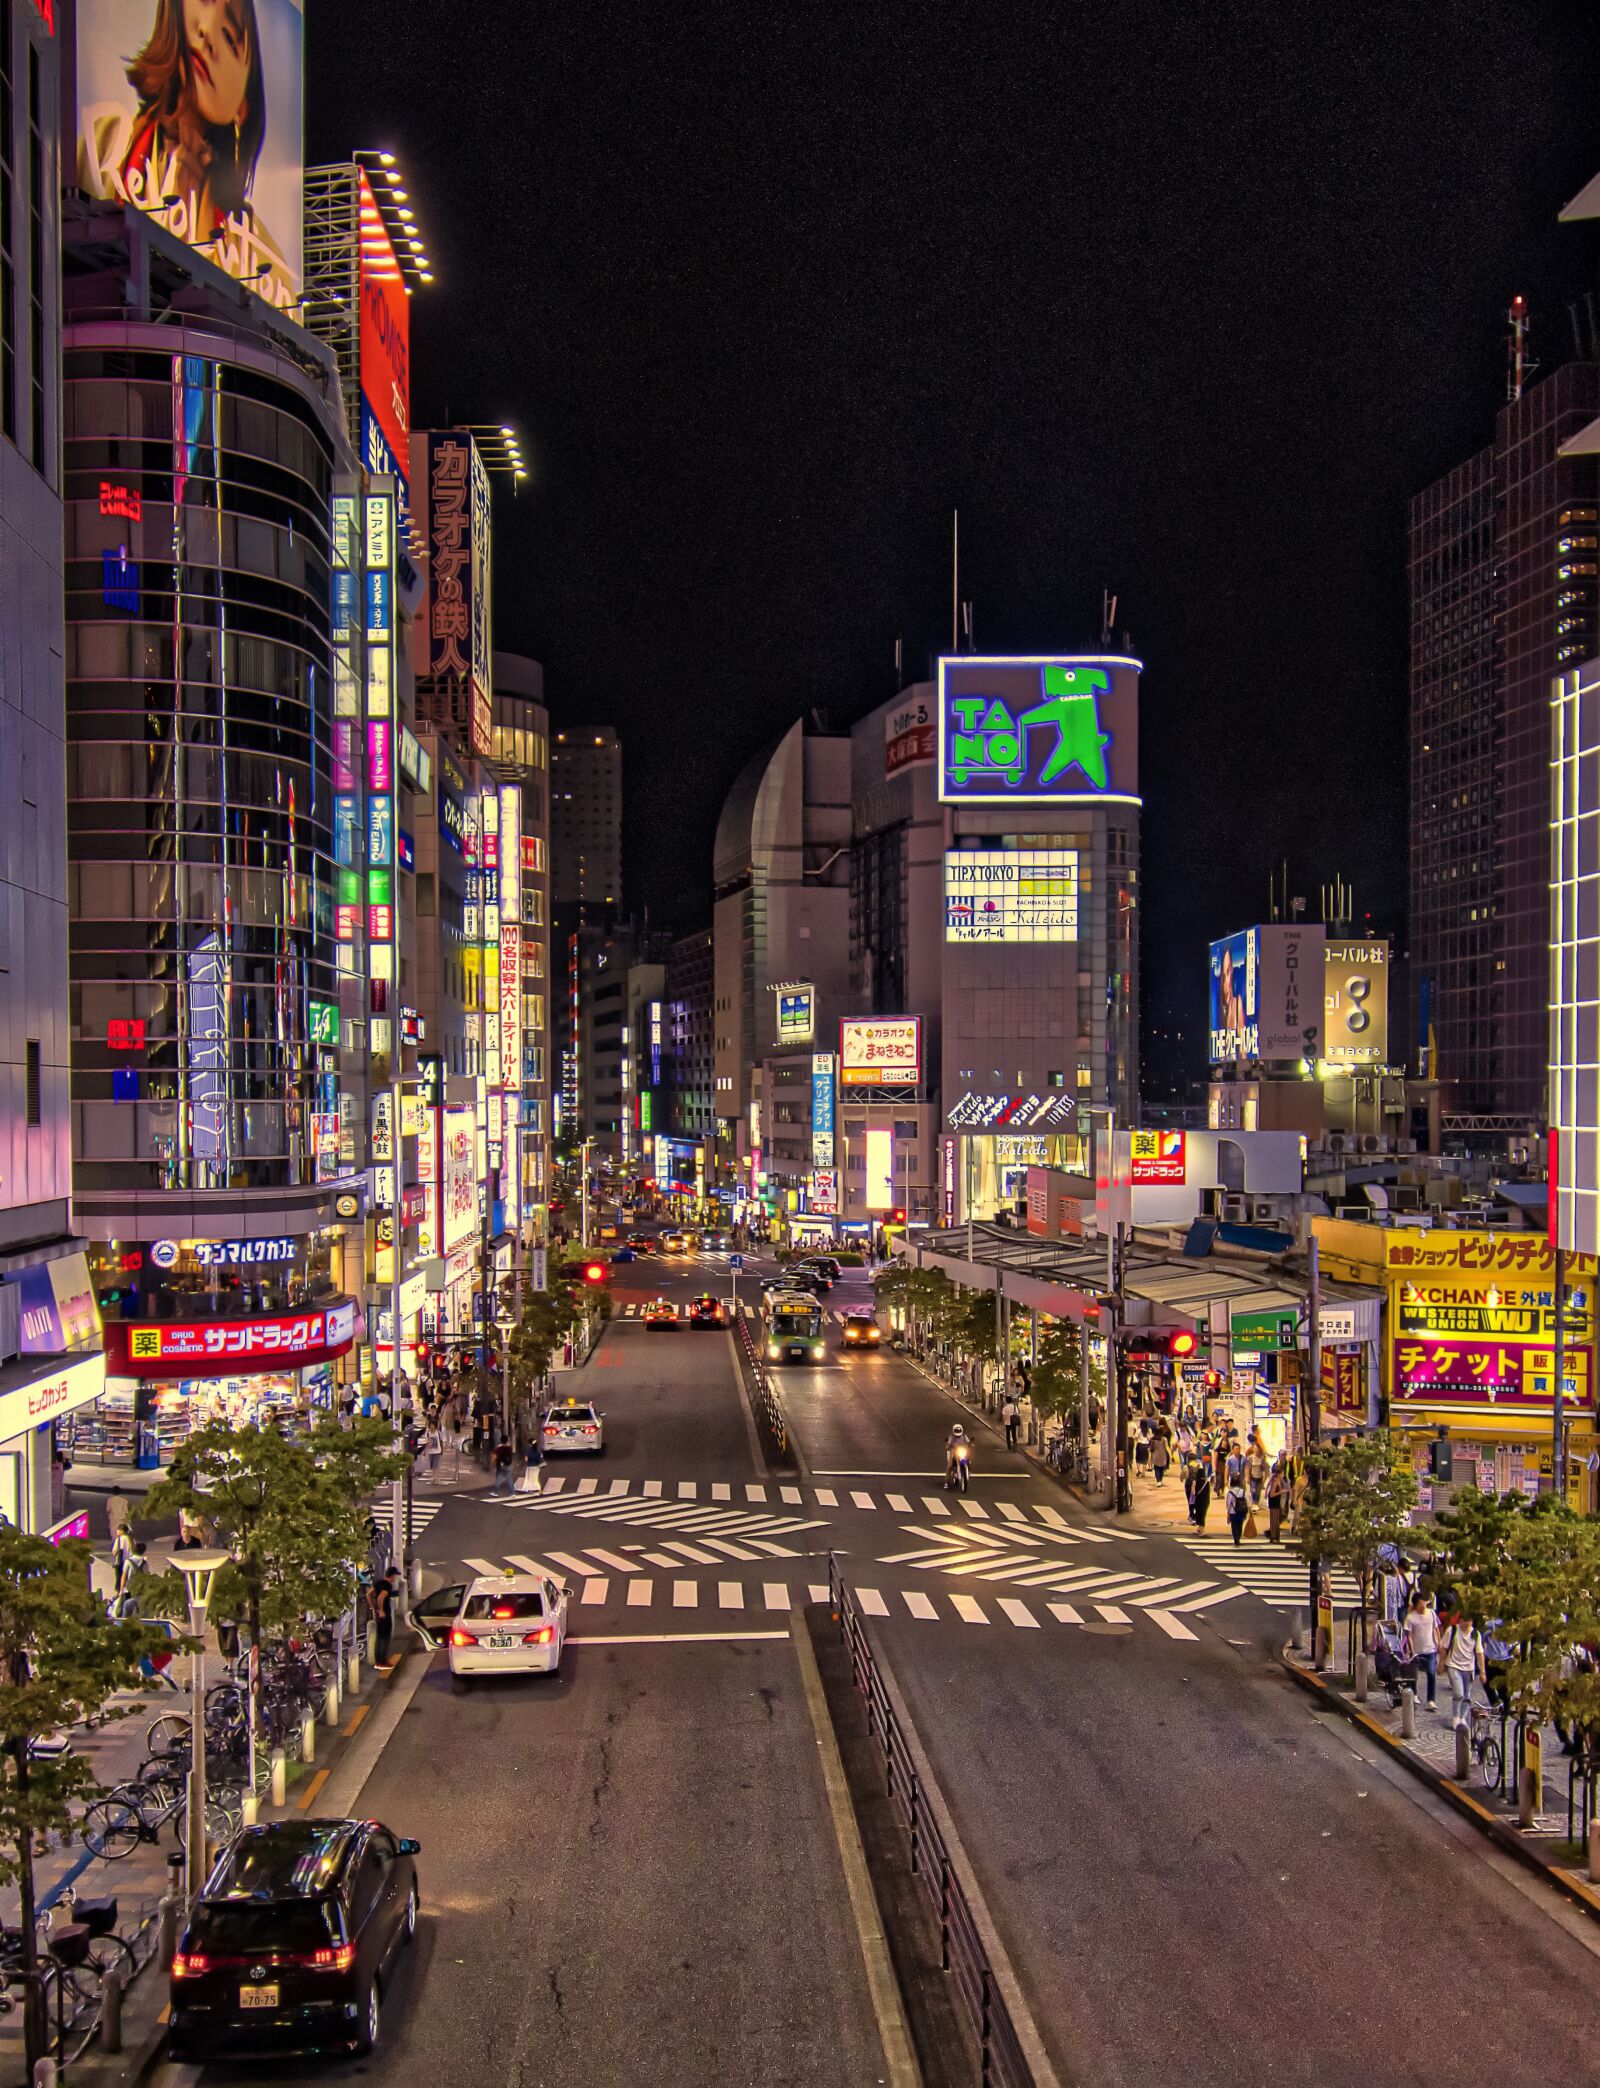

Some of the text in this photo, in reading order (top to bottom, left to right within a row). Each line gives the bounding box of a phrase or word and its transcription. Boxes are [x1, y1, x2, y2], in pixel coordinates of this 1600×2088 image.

[432, 440, 470, 675] カラオケの鉄人
[980, 865, 1014, 880] TOKYO
[1010, 910, 1074, 924] Kaleido
[1286, 942, 1299, 1026] グローバル社
[501, 927, 517, 1088] 100名収容大パーティールーム
[875, 1029, 906, 1037] カラオケ
[865, 1043, 914, 1060] まねきねこ
[1136, 1135, 1155, 1155] 薬
[195, 1240, 296, 1265] サンマルクカフェ
[1400, 1288, 1517, 1305] EXCHANGE
[1404, 1307, 1480, 1319] WESTERN
[1489, 1310, 1532, 1332] WU
[1427, 1318, 1480, 1330] UNION
[135, 1332, 157, 1355] 薬
[171, 1331, 195, 1339] DRUG
[204, 1321, 308, 1353] サンドラッグ
[163, 1342, 204, 1354] COSMETIC
[1399, 1346, 1519, 1377] チケット
[1339, 1358, 1352, 1406] チケット
